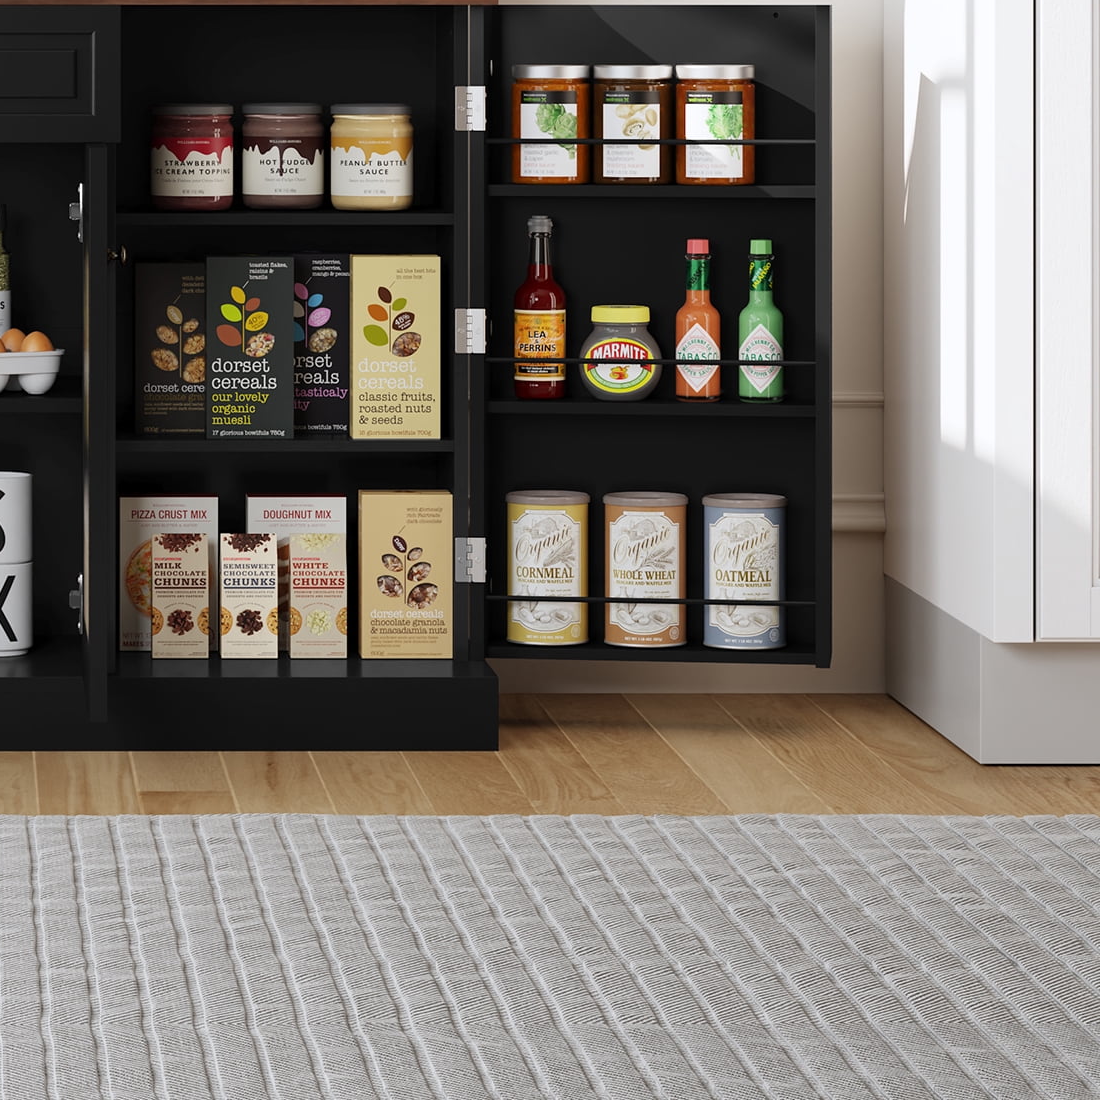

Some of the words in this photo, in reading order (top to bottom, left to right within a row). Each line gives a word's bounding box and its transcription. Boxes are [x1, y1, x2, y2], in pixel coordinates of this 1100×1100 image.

[520, 344, 556, 352] PERRINS
[593, 342, 646, 359] MARMITE
[293, 353, 333, 368] rset
[677, 352, 717, 360] TABASCO
[741, 352, 781, 361] TABASCO
[211, 357, 270, 373] dorset
[357, 357, 418, 373] dorset
[211, 374, 277, 389] cereals
[294, 369, 340, 384] reals
[357, 374, 424, 389] cereals
[143, 382, 180, 393] dorset
[181, 384, 205, 393] cere
[295, 387, 348, 399] tasticaly
[212, 394, 233, 402] our
[234, 392, 269, 404] lovely
[358, 392, 398, 402] classic
[400, 392, 436, 402] fruits,
[212, 404, 256, 415] organic
[358, 404, 402, 413] roasted
[405, 404, 432, 413] nuts
[212, 415, 252, 425] muesli
[358, 415, 369, 425] &
[371, 415, 403, 425] seeds
[131, 510, 156, 519] PIZZA
[158, 510, 188, 519] CRUST
[190, 510, 207, 519] MIX
[263, 510, 312, 519] DOUGHNUT
[315, 510, 332, 519] MIX
[515, 524, 572, 565] Organic
[613, 526, 670, 566] Organic
[713, 527, 770, 568] Organic
[516, 566, 574, 579] CORNMEAL
[613, 569, 643, 580] WHOLE
[645, 570, 677, 580] WHEAT
[715, 569, 772, 582] OATMEAL
[154, 578, 206, 586] CHUNKS
[223, 578, 276, 586] CHUNKS
[292, 578, 345, 586] CHUNKS
[370, 609, 404, 619] dorset
[406, 609, 444, 619] cereals
[412, 619, 445, 627] granola
